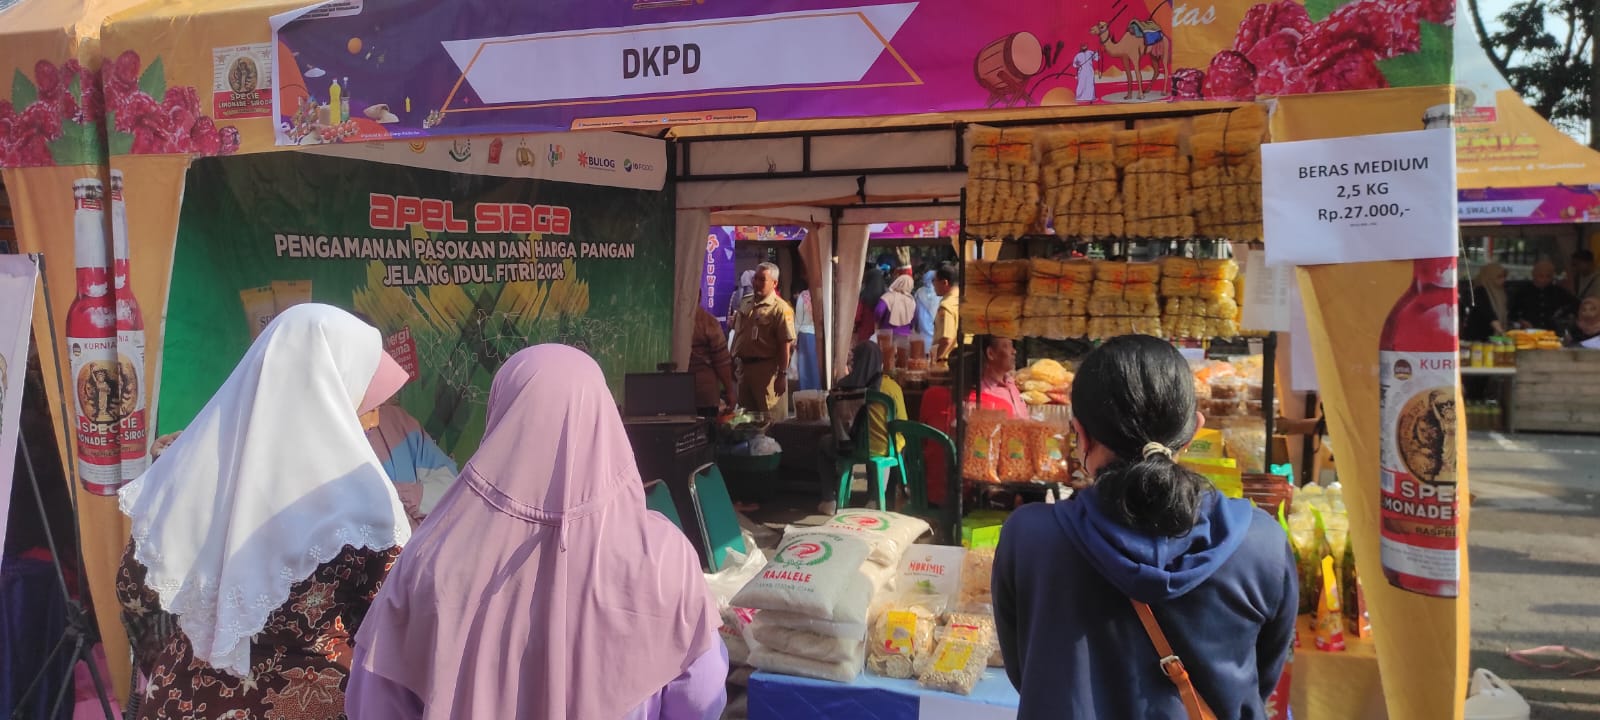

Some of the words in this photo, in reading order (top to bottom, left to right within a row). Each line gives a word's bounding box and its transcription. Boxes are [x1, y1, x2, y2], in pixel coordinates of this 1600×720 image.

[623, 43, 701, 79] DKPD
[230, 92, 260, 101] SPECIE
[588, 156, 616, 168] BULOG
[1299, 163, 1349, 179] BERAS
[1354, 157, 1429, 175] MEDIUM
[1336, 184, 1361, 199] 2,5
[1366, 182, 1389, 196] KG
[1318, 203, 1411, 222] Rp.27.000,-
[1466, 206, 1513, 215] SWALAYAN
[274, 233, 410, 259] PENGAMANAN
[414, 239, 496, 260] PASOKAN
[500, 241, 531, 259] DAN
[535, 241, 577, 259] HARGA
[580, 242, 635, 259] PANGAN
[383, 264, 450, 286] JELANG
[454, 264, 493, 284] IDUL
[496, 263, 535, 282] FITRI
[537, 262, 566, 280] 2024
[83, 342, 117, 351] KURNIA
[1401, 481, 1458, 502] SPE
[763, 570, 812, 583] RAJALELE
